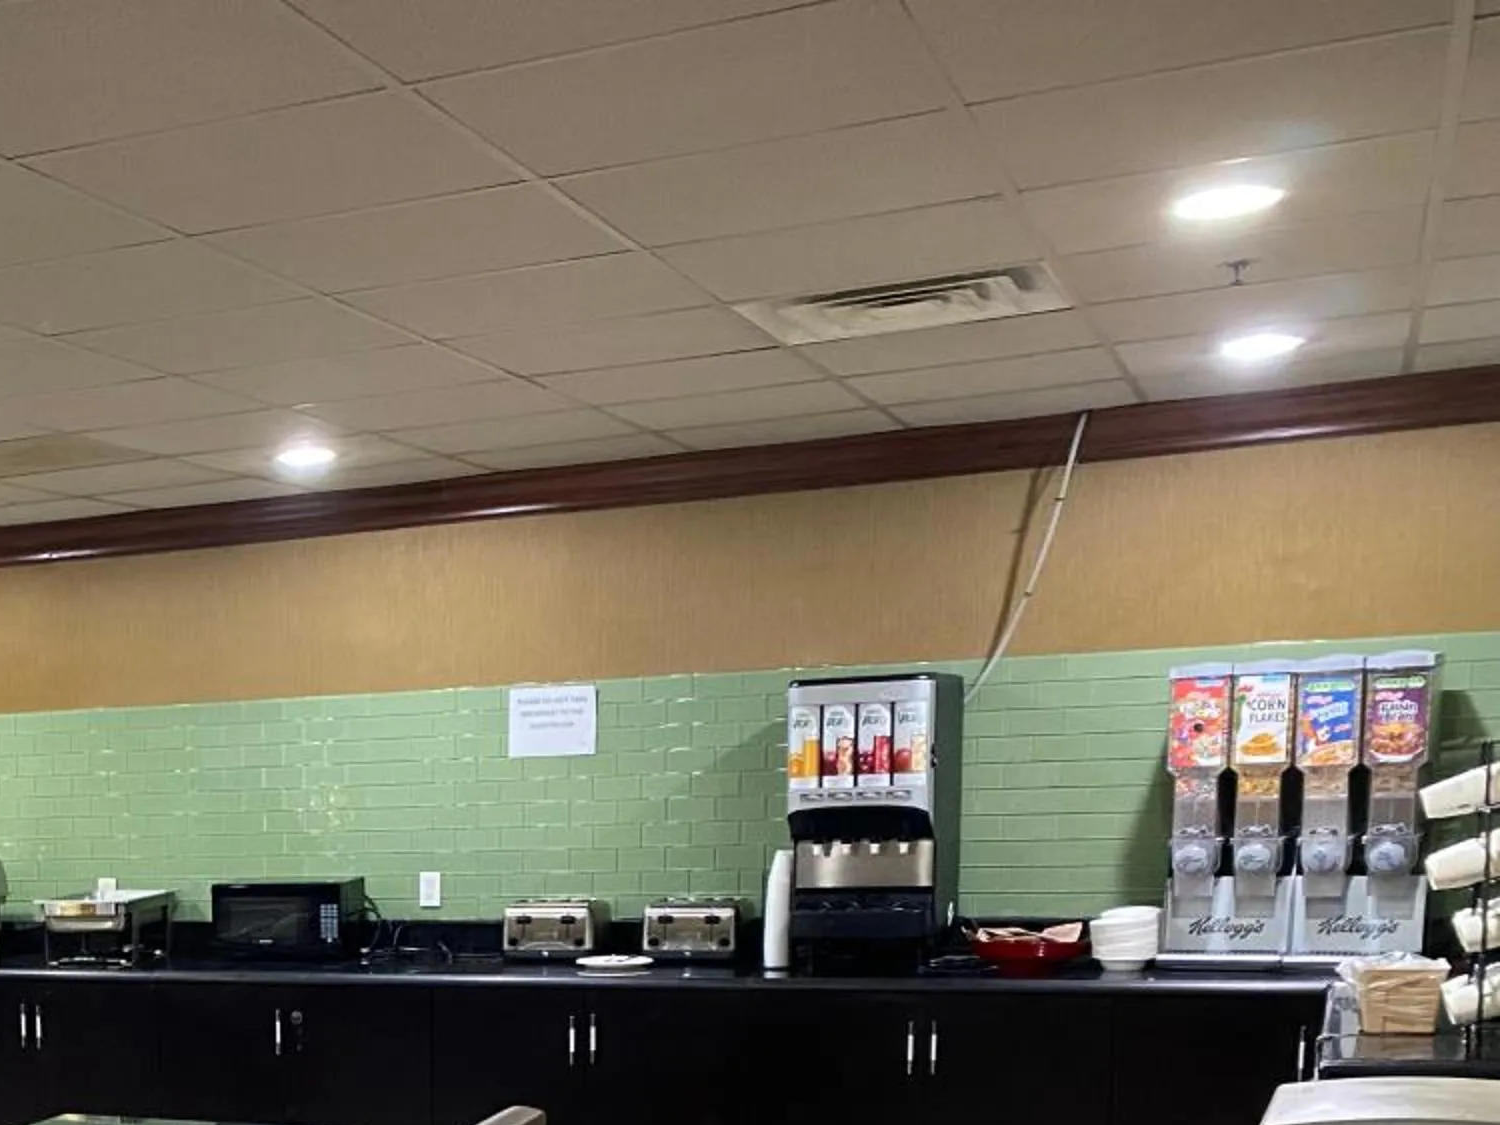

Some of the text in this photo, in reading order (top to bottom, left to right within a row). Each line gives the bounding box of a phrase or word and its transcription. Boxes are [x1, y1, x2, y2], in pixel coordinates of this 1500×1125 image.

[1250, 699, 1286, 711] CORN
[1248, 711, 1286, 723] FLAKES
[1188, 915, 1265, 940] Kellogg's
[1317, 914, 1400, 940] Kellogg's
